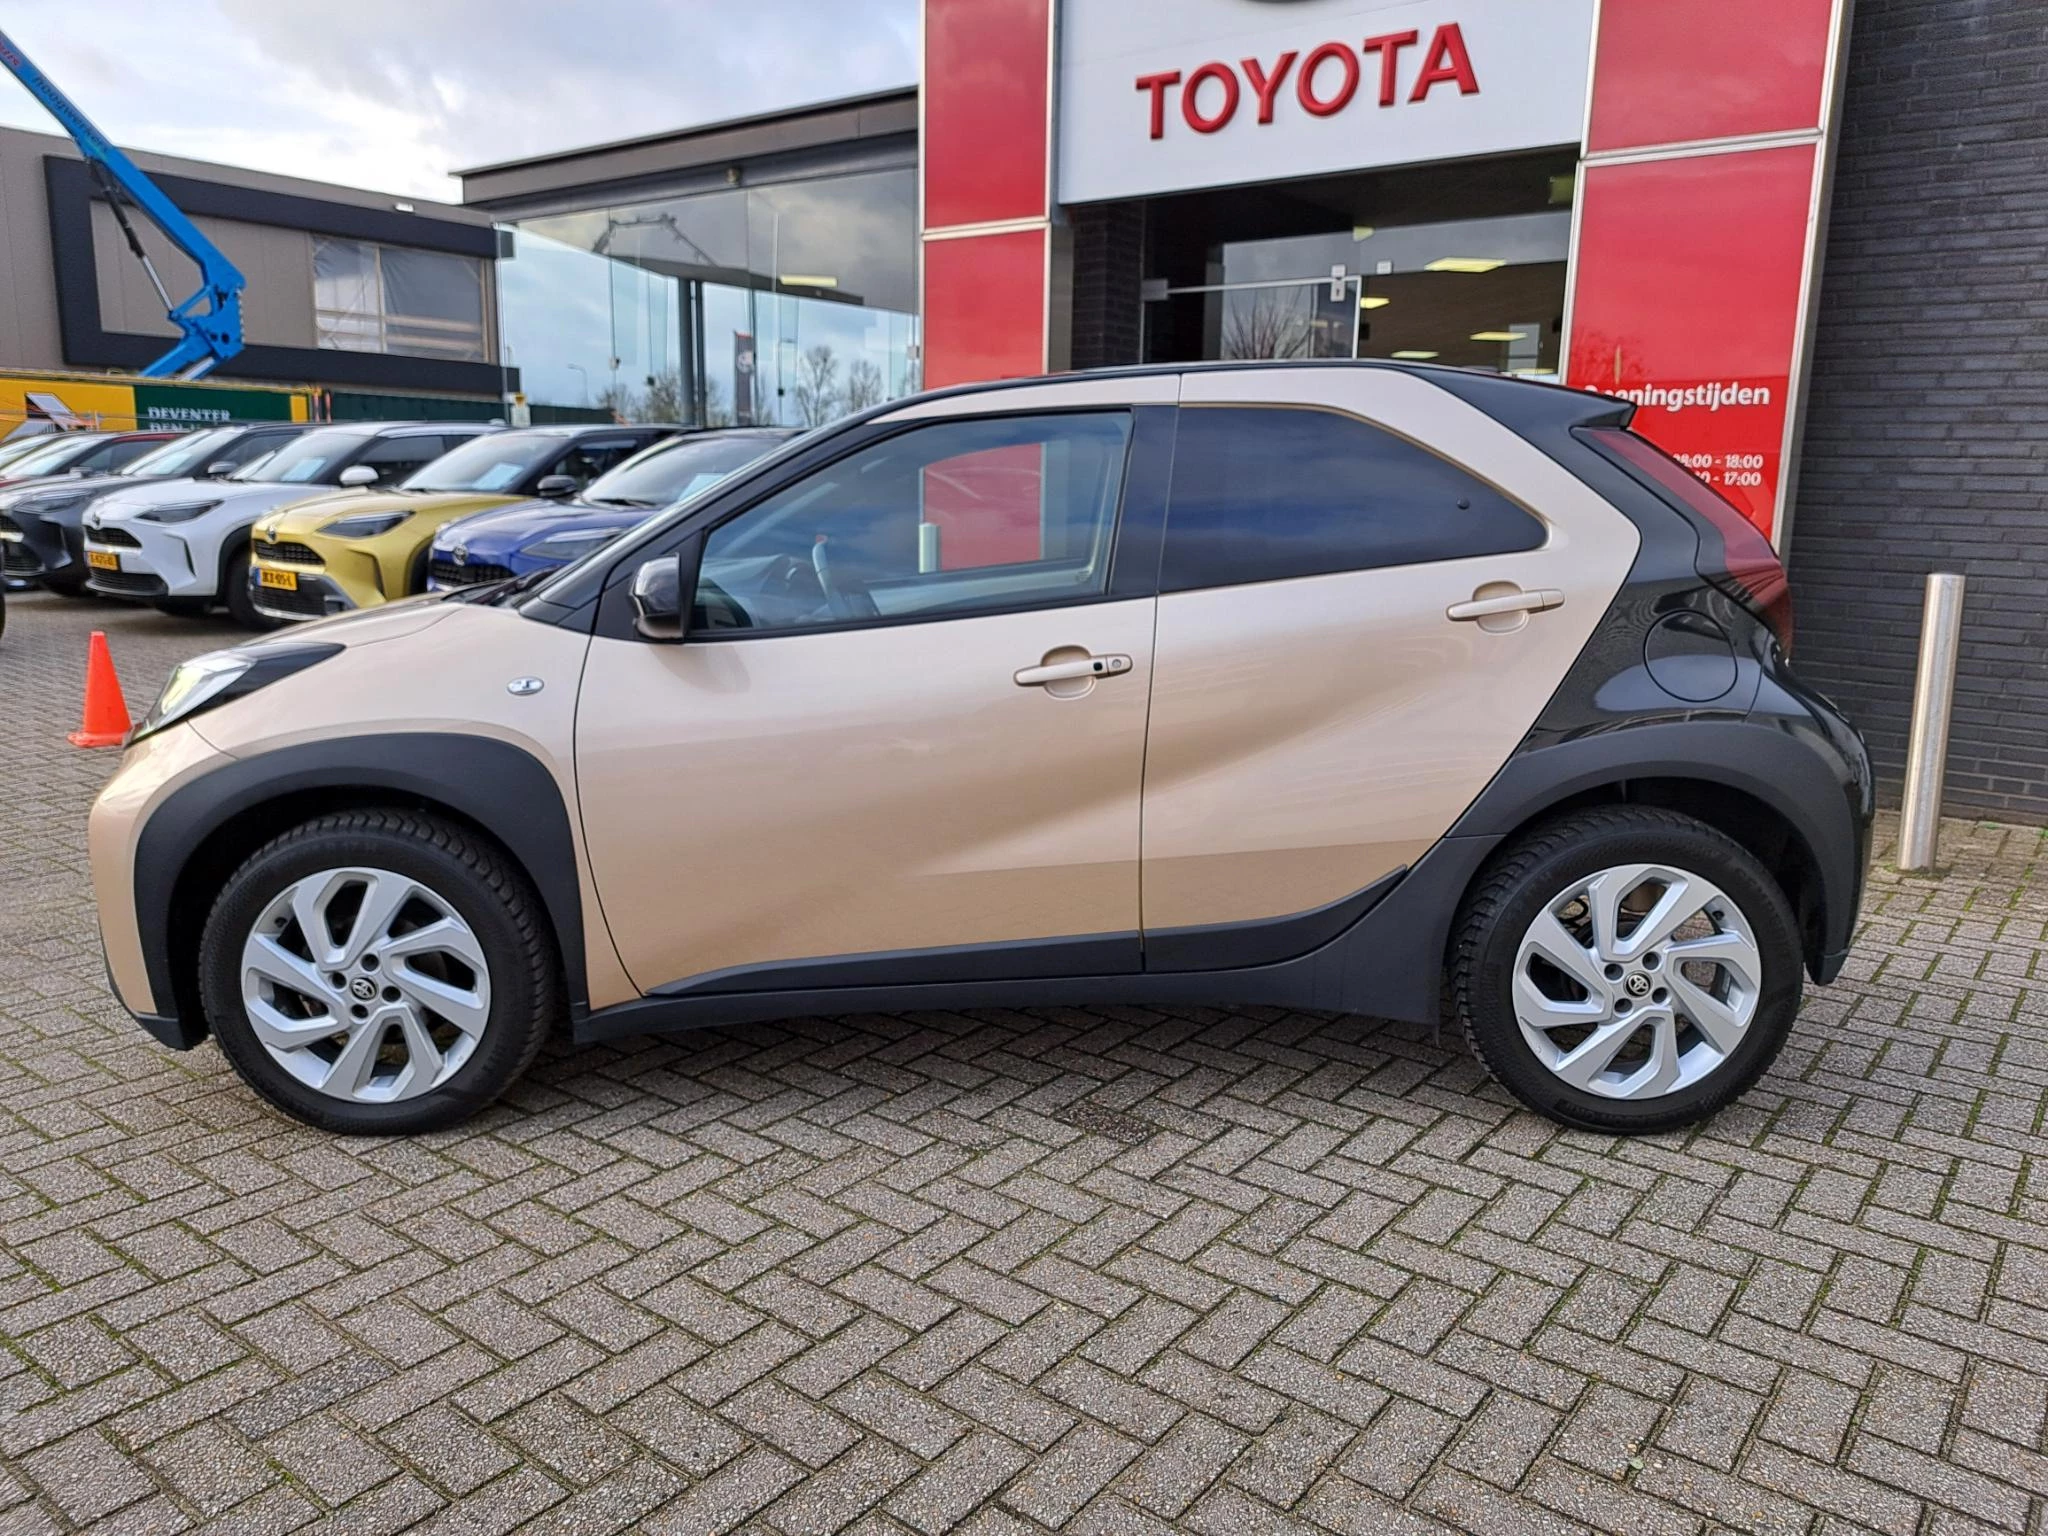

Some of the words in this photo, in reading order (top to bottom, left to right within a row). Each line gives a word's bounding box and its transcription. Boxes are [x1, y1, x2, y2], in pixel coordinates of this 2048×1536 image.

[1135, 22, 1480, 140] TOYOTA
[147, 406, 231, 421] DEVENTER
[1724, 454, 1764, 469] 18:00
[1723, 471, 1762, 486] 17:00
